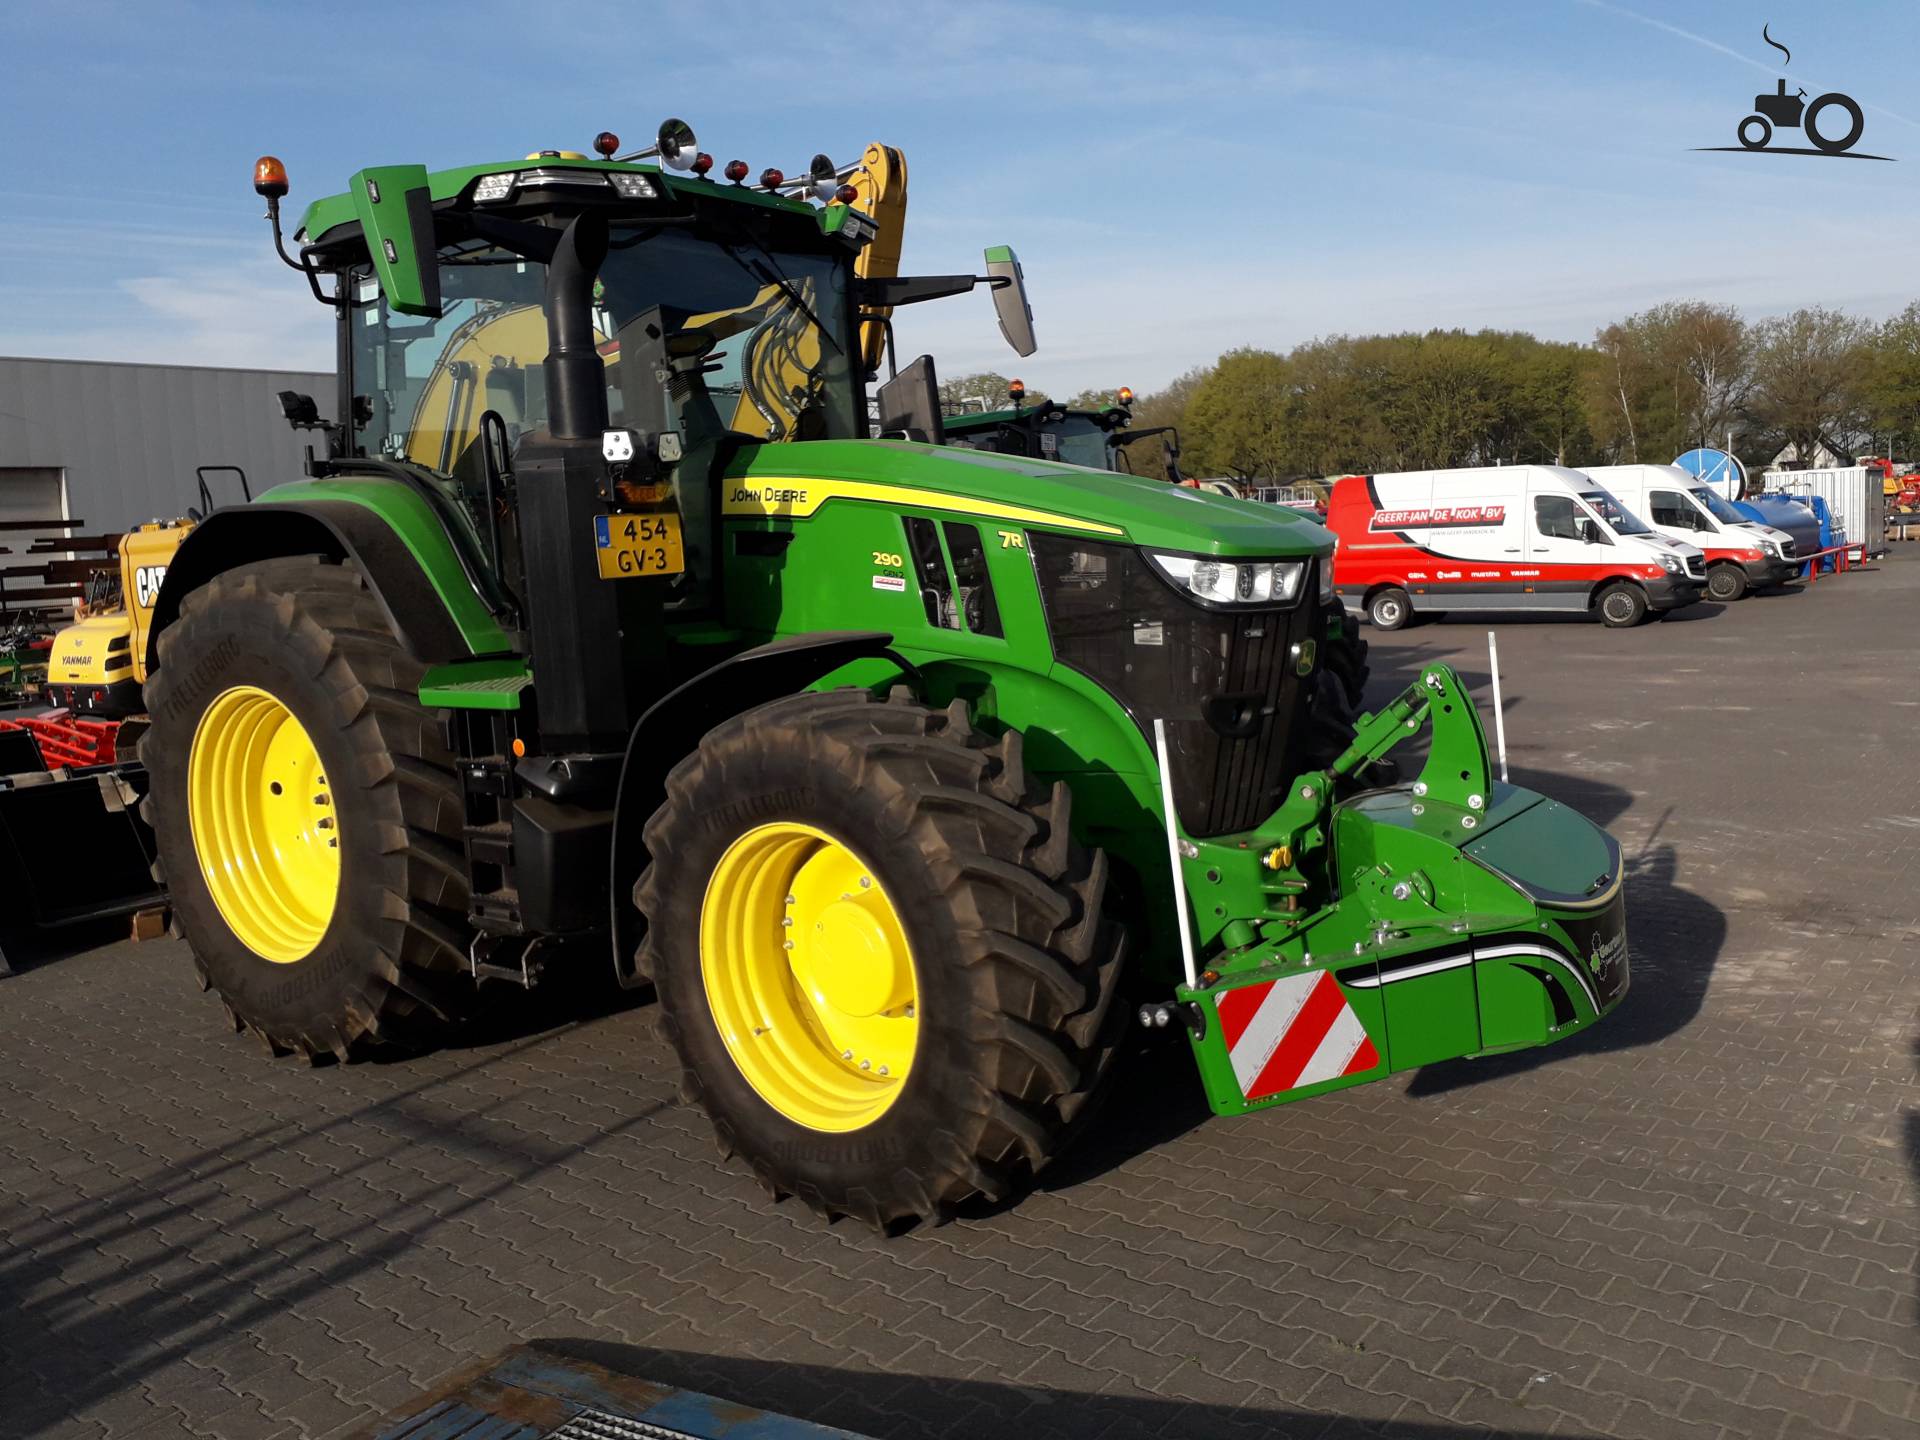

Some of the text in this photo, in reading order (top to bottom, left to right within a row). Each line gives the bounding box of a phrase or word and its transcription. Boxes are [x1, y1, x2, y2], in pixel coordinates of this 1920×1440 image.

[730, 487, 807, 503] JOHN DEERE
[1377, 507, 1502, 524] GEERT-JAN DE KOK BV
[624, 518, 667, 542] 454
[997, 530, 1025, 549] 7R
[617, 548, 668, 573] GV-3
[872, 551, 902, 567] 290
[61, 655, 92, 666] YANMAR
